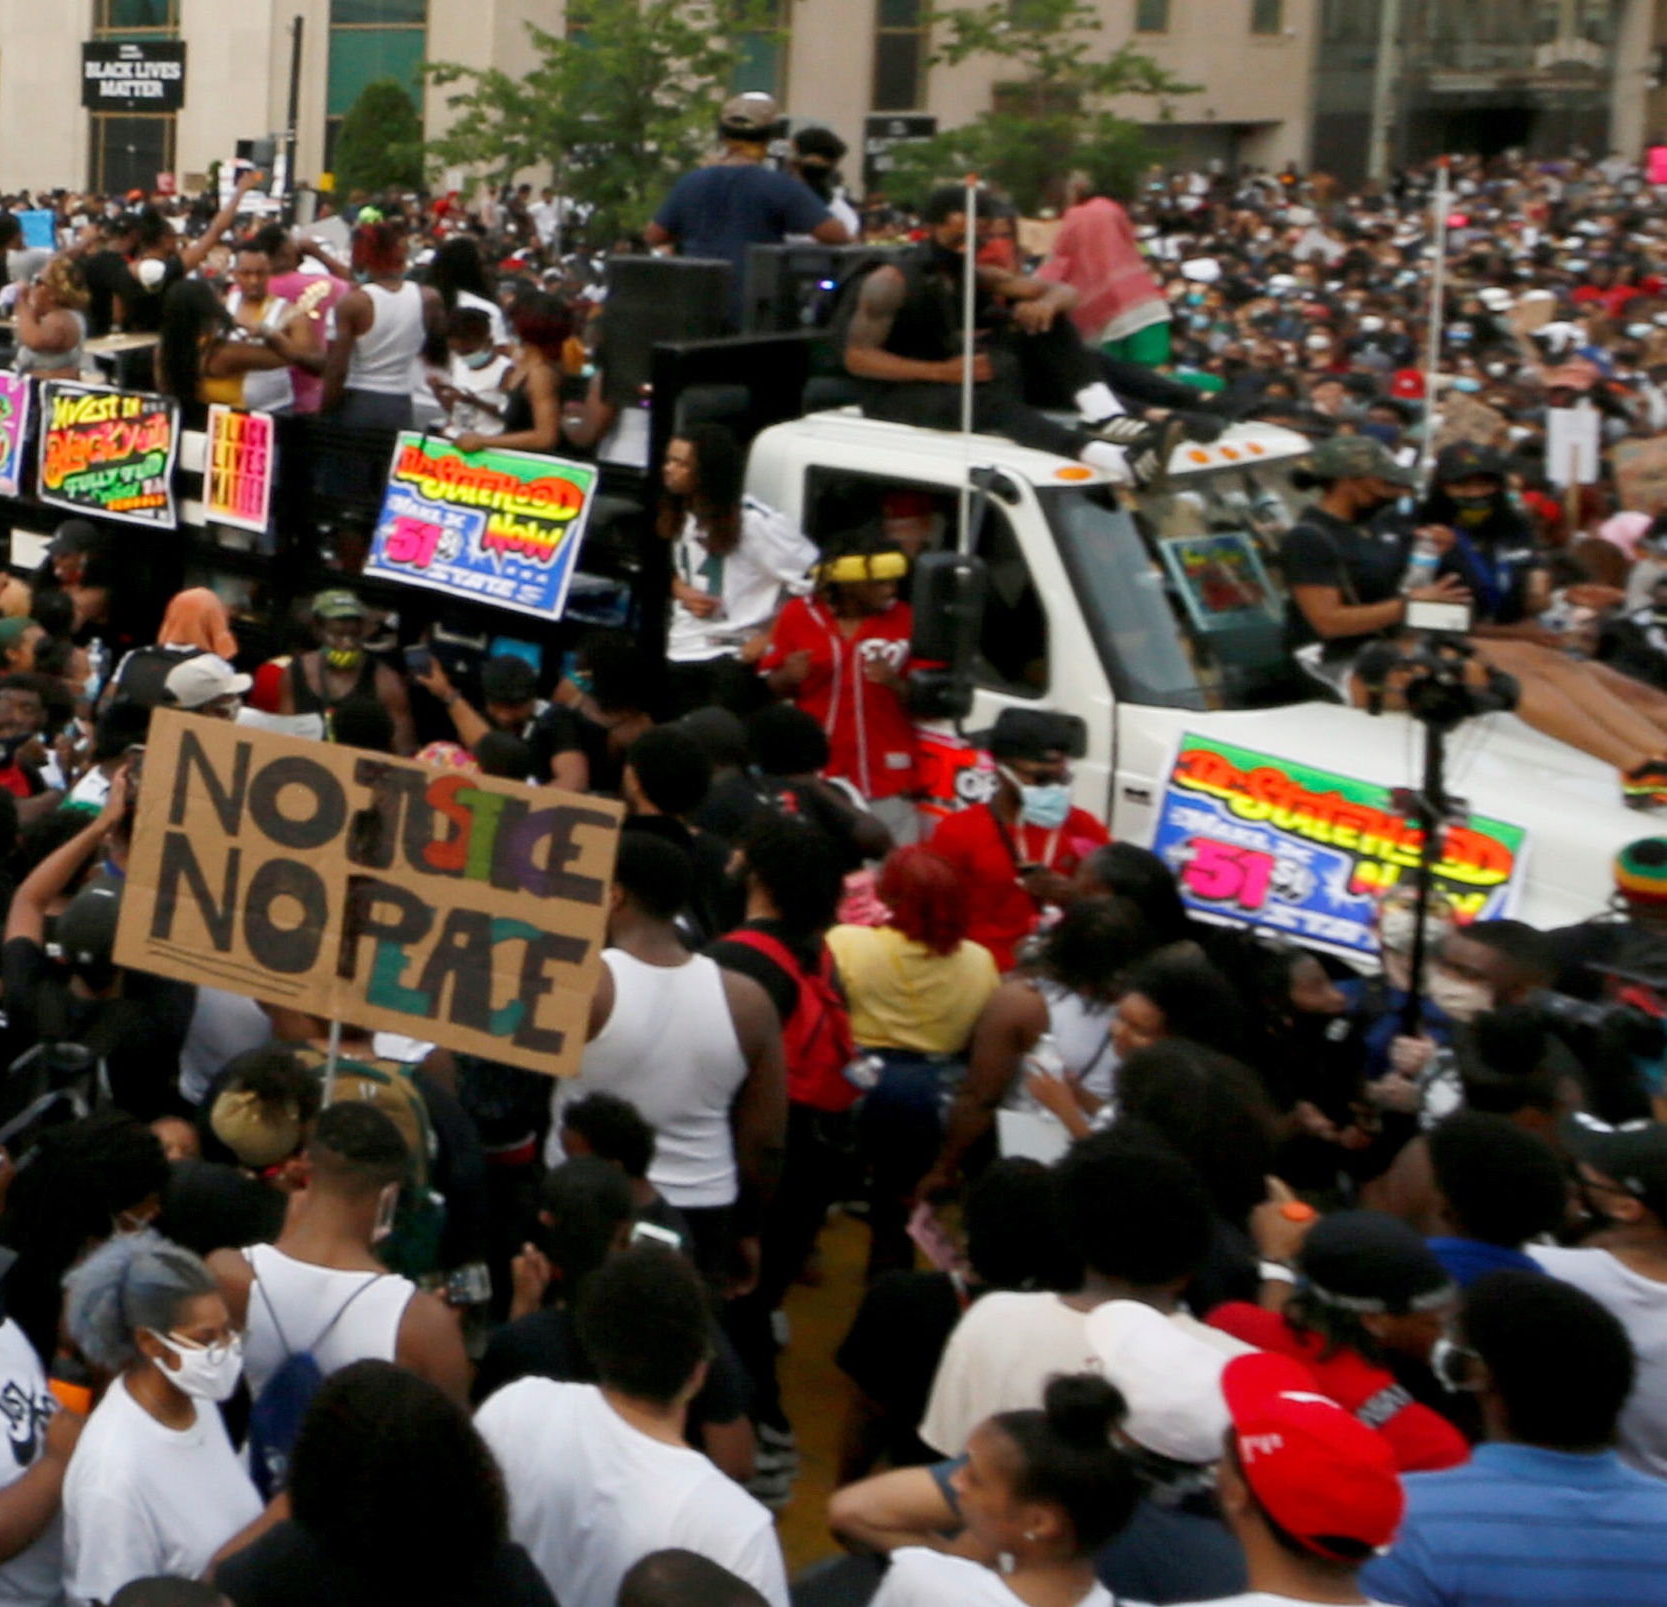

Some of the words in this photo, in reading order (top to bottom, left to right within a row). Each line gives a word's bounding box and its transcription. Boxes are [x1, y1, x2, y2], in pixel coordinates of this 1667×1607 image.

[85, 61, 133, 79] BLACK
[135, 61, 181, 79] LIVES
[99, 80, 164, 98] MATTER
[169, 729, 348, 850] NO
[346, 757, 618, 907] JUSTICE
[150, 831, 329, 975] NO
[336, 873, 591, 1055] PEACE
